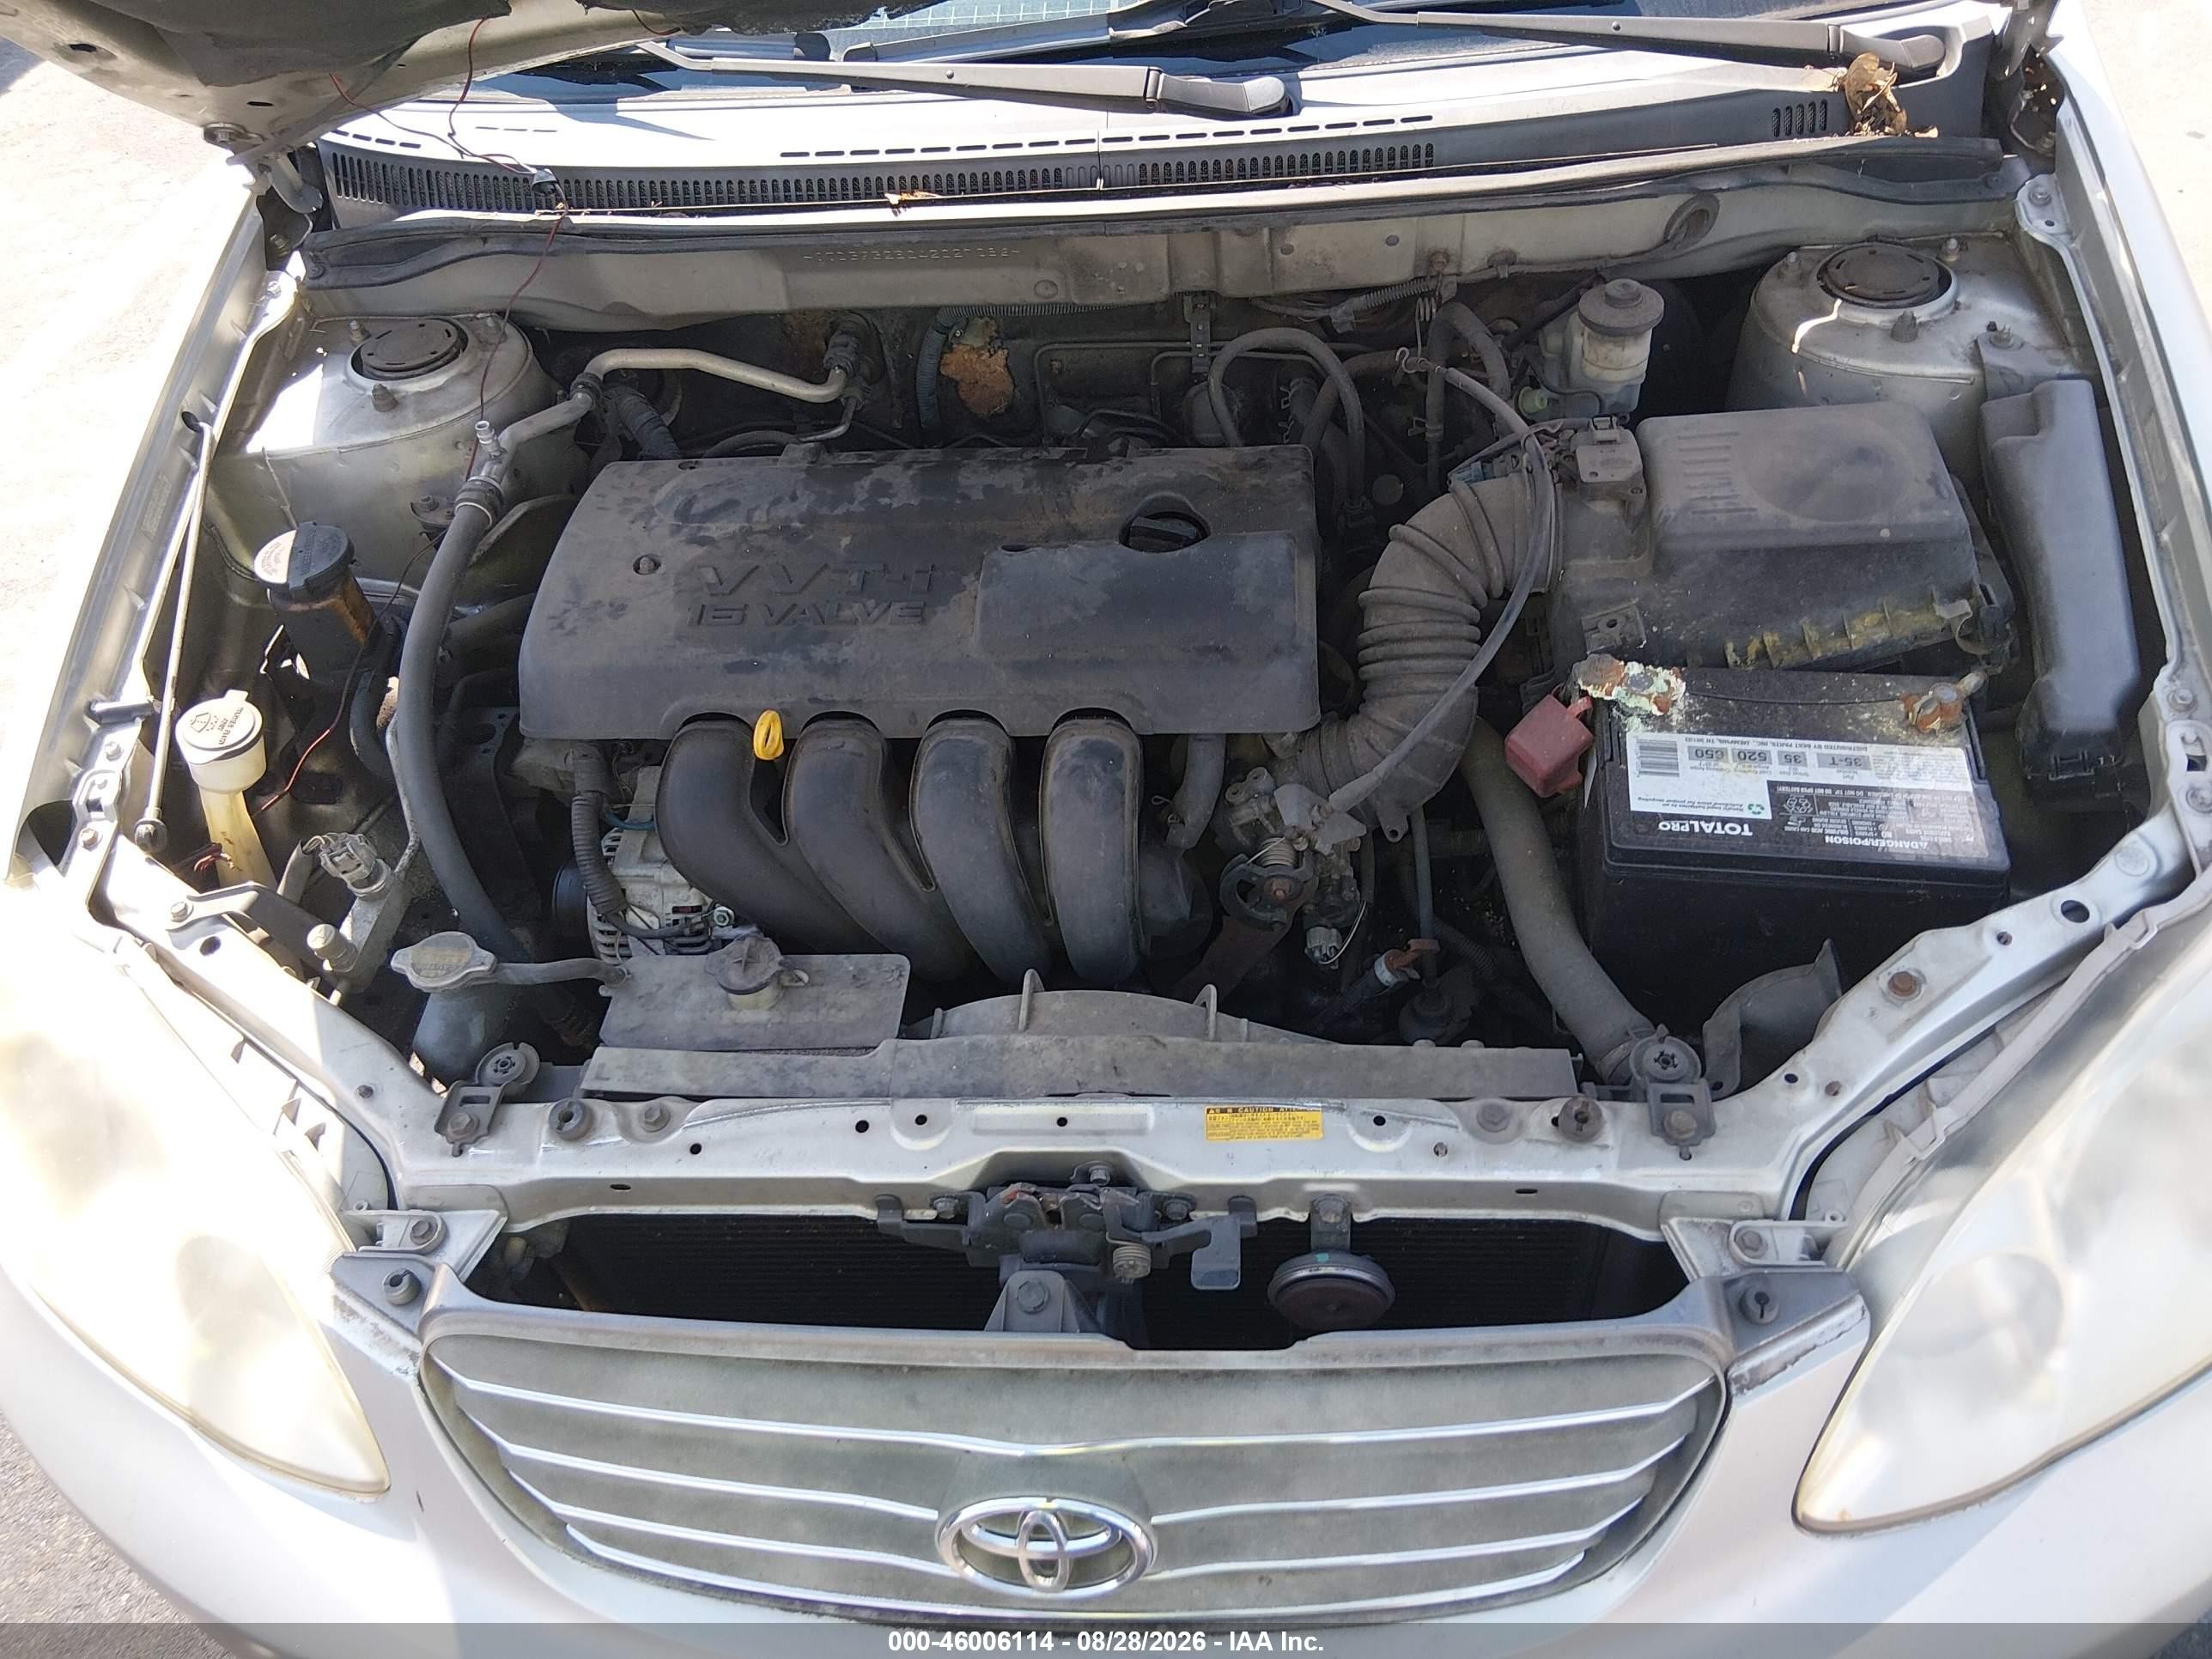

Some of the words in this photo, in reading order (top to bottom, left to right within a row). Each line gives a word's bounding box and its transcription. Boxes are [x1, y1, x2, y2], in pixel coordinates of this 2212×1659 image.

[688, 603, 749, 626] 16
[765, 600, 926, 626] VALVE
[1738, 750, 1766, 762] 520
[1784, 755, 1802, 763] 35
[1829, 757, 1862, 767] 35-T
[1658, 820, 1753, 836] TOTALPRO
[1825, 836, 1918, 848] DANGER/POISON
